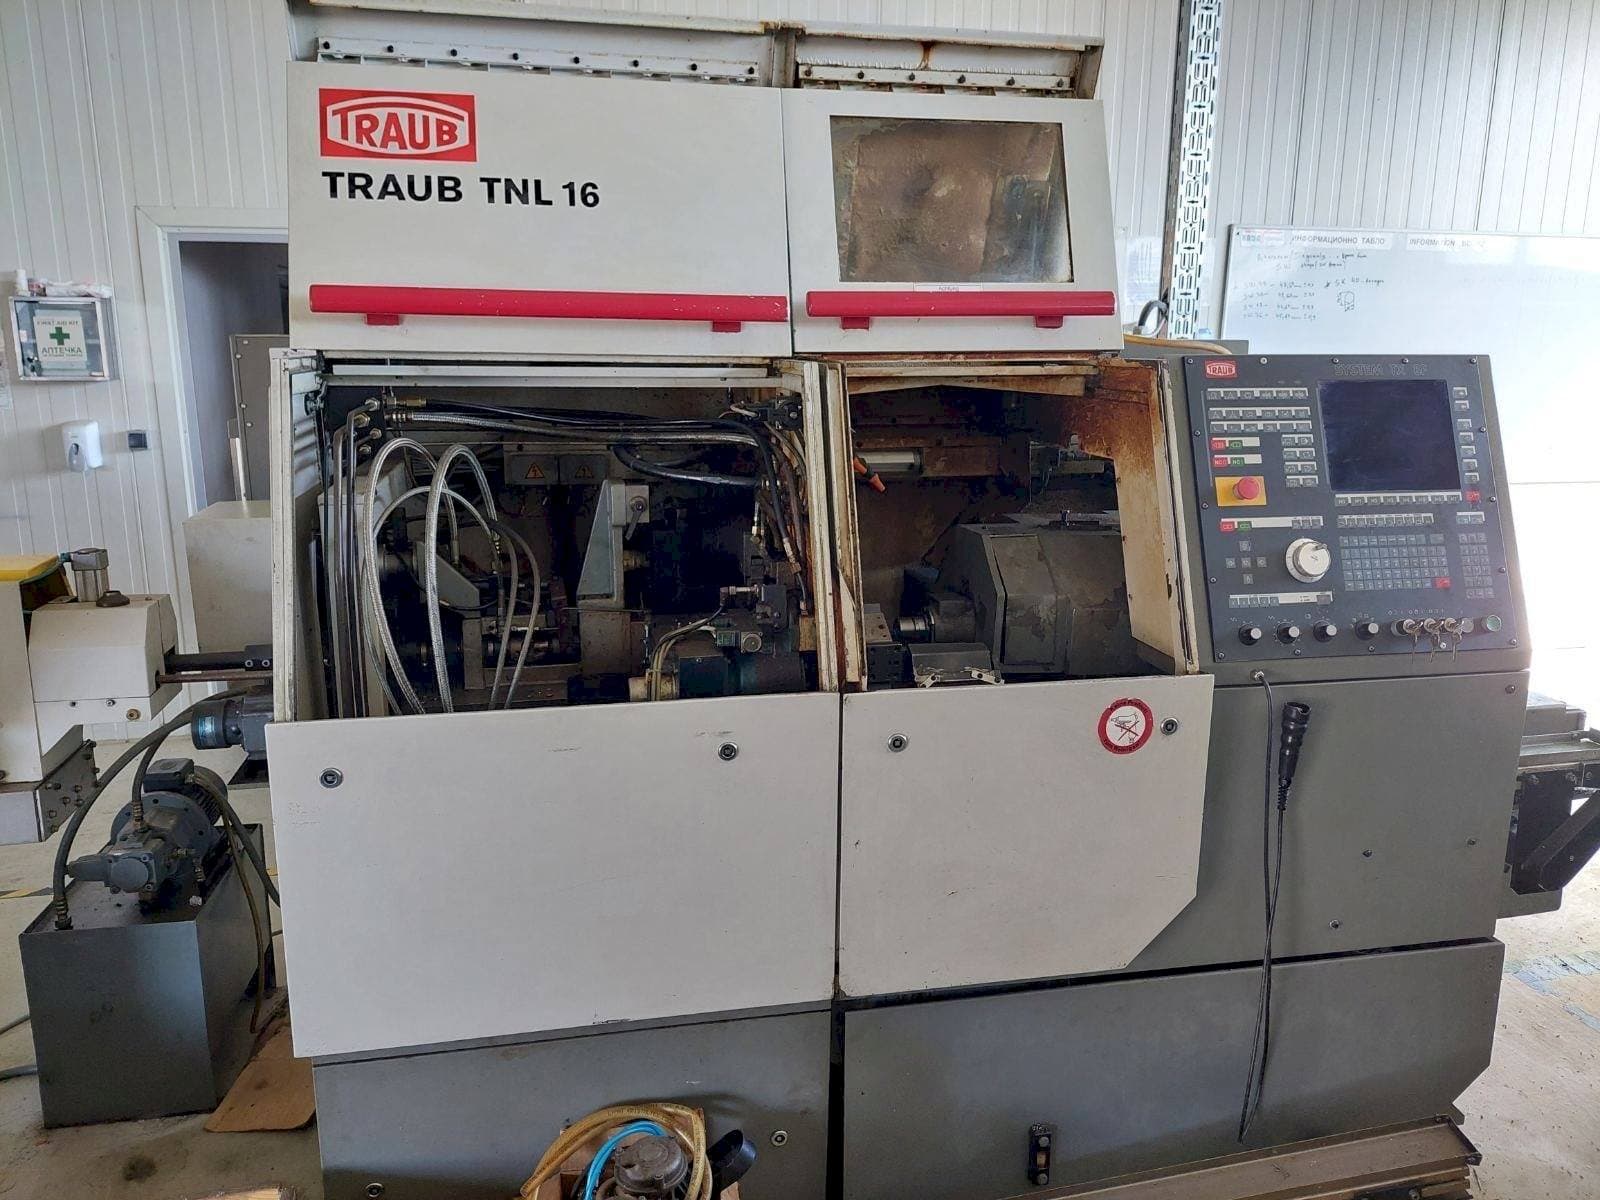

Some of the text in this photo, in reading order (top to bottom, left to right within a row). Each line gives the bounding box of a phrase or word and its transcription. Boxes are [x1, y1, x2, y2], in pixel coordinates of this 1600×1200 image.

[331, 101, 465, 150] TRAUB
[321, 171, 600, 208] TRAUB TNL 16
[42, 346, 82, 354] АПТЕЧКА
